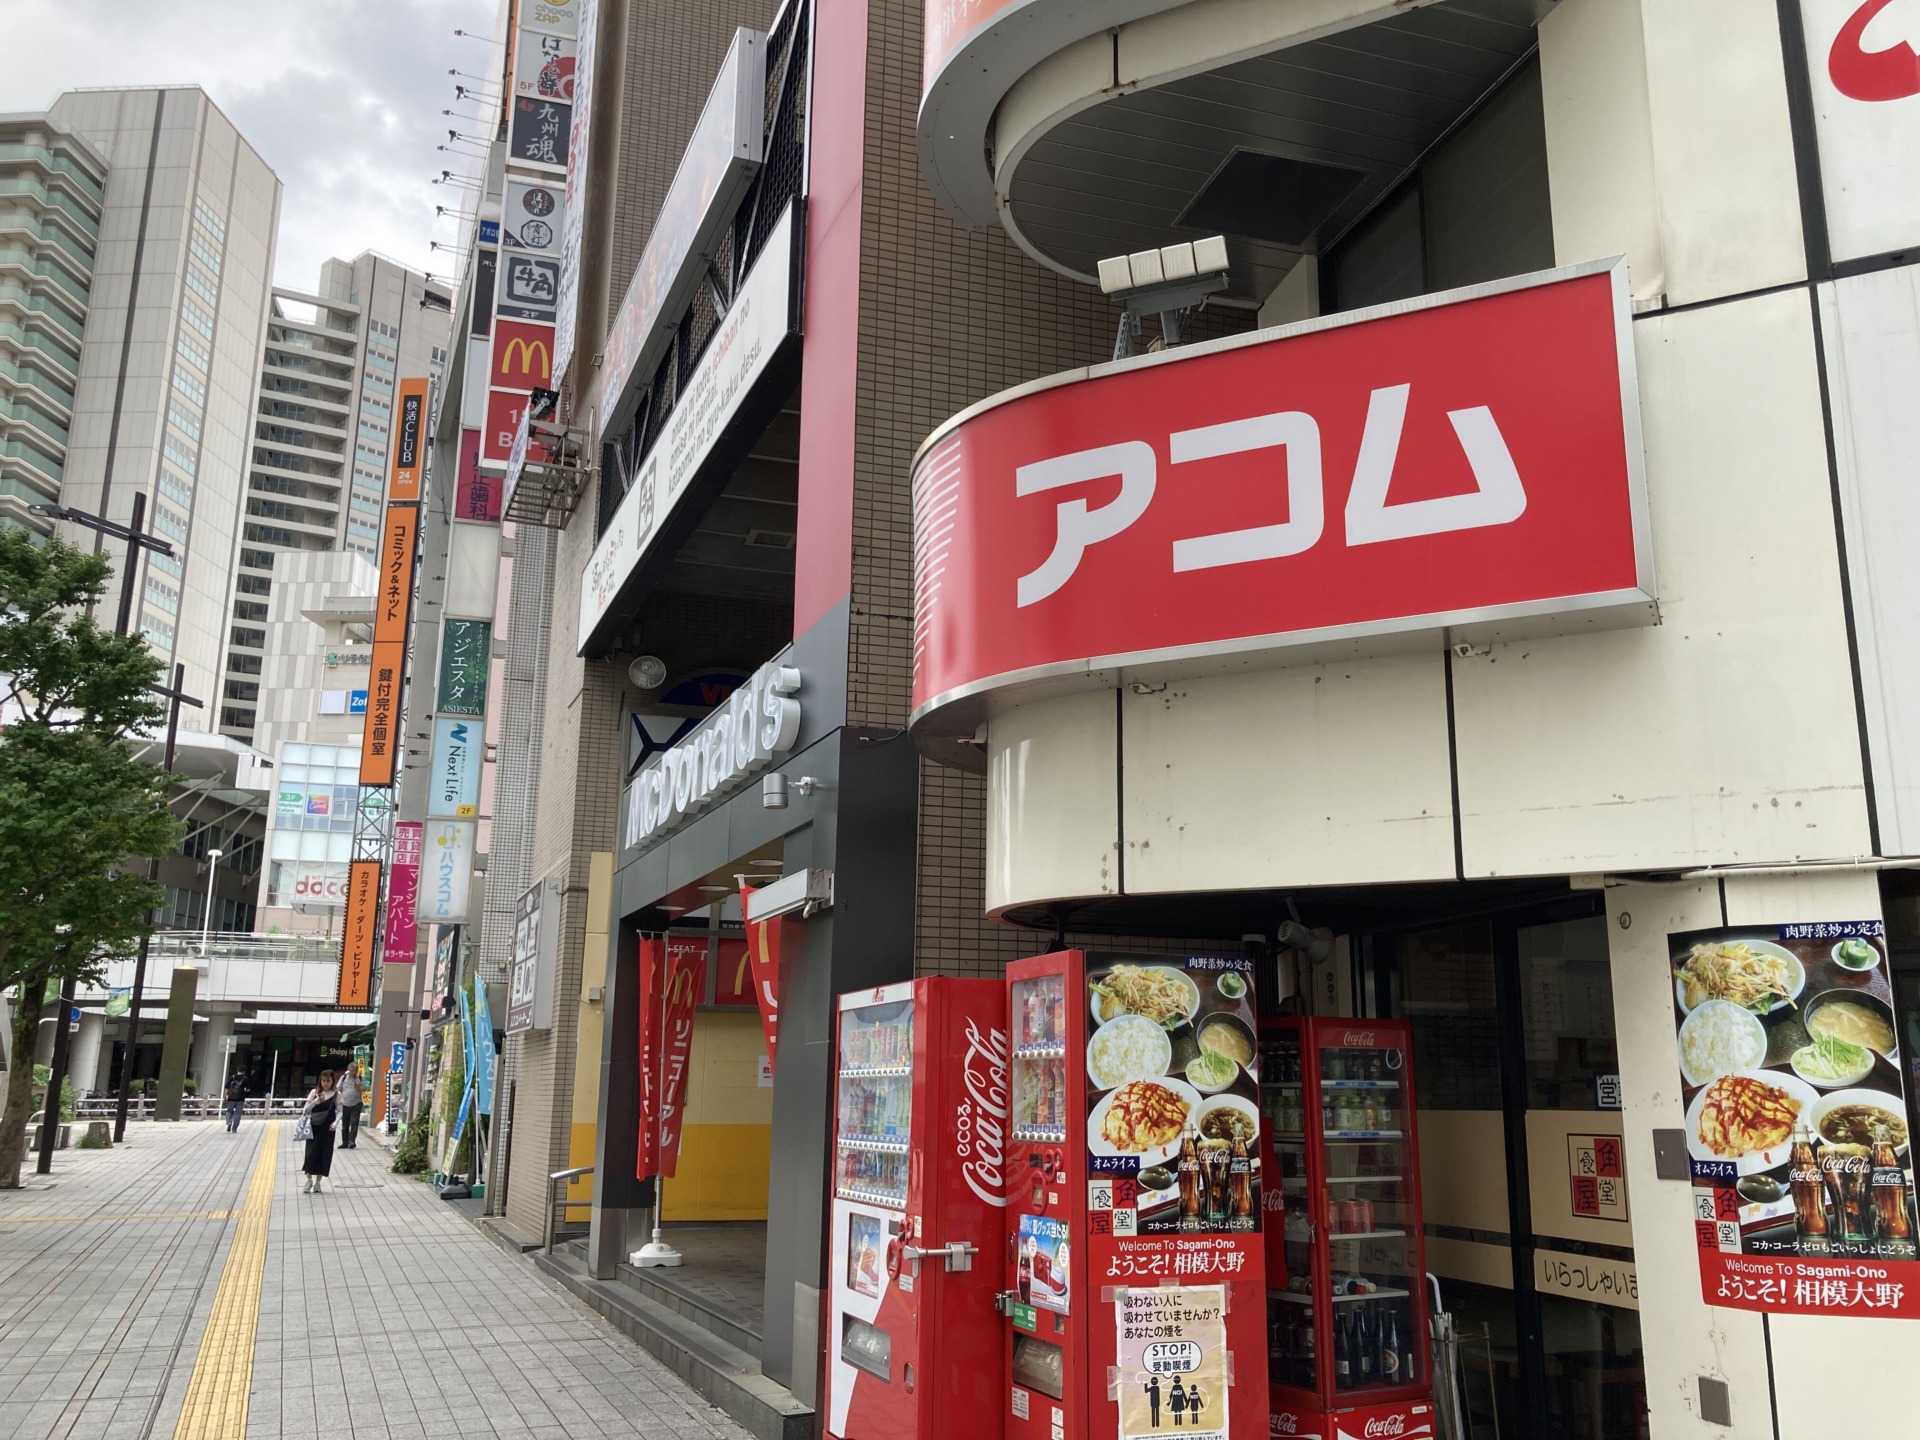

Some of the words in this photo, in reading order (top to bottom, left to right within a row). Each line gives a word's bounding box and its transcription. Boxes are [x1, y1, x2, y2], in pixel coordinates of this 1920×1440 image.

[535, 4, 574, 18] choco
[535, 12, 560, 24] ZAP
[520, 81, 535, 91] 5F
[526, 103, 559, 163] 九州魂
[504, 238, 516, 246] 3F
[514, 266, 553, 296] 牛角
[521, 310, 540, 319] 2F
[713, 318, 738, 374] ichiban
[740, 298, 750, 327] no
[740, 338, 761, 383] desu.
[403, 401, 418, 463] 快活CLUB
[398, 471, 411, 479] 24
[1016, 383, 1528, 608] アコム
[387, 526, 406, 621] コミック&ネット
[449, 622, 471, 701] アジエスタ
[371, 668, 393, 756] 鍵付完全個室
[441, 704, 480, 714] ASIESTA
[447, 745, 462, 776] Next
[625, 662, 801, 850] McDonald's
[445, 779, 459, 802] Life
[398, 828, 422, 838] 売買
[396, 854, 420, 865] 店舗
[436, 852, 453, 916] ハウスコム
[404, 868, 419, 929] マンション
[390, 895, 404, 944] アパート
[350, 871, 369, 997] カラオケ・ダーツ・ビリヤード
[1785, 921, 1884, 939] 肉野菜炒め定食
[1189, 957, 1252, 971] 肉野菜炒め定食
[1343, 1031, 1375, 1046] Coca-Cola
[1600, 1077, 1622, 1105] 営
[962, 1016, 1006, 1207] Coca-Cola
[1094, 1158, 1136, 1170] オムライス
[1199, 1149, 1231, 1164] Coca-Cola
[1822, 1155, 1871, 1174] Coca-Cola
[1178, 1159, 1200, 1172] Coca-Cola
[1230, 1162, 1250, 1172] Coca-Cola
[1695, 1162, 1734, 1176] オムライス
[1789, 1168, 1823, 1182] Coca-Cola
[1872, 1172, 1902, 1184] Coca-Cola
[1119, 1240, 1162, 1251] Welcome
[1163, 1240, 1175, 1250] To
[1176, 1239, 1235, 1251] Sagami-Ono
[1725, 1258, 1773, 1275] Welcome
[1776, 1262, 1793, 1275] To
[1796, 1263, 1887, 1279] Sagami-Ono
[1124, 1295, 1183, 1309] 吸わない人に
[1124, 1308, 1220, 1324] 吸わせていませんか?
[1124, 1324, 1183, 1339] あなたの煙を
[1152, 1343, 1192, 1357] STOP!
[1153, 1360, 1191, 1372] 受動喫煙
[1270, 1412, 1298, 1433] ca-Cola
[1364, 1414, 1406, 1439] Coca-Cola
